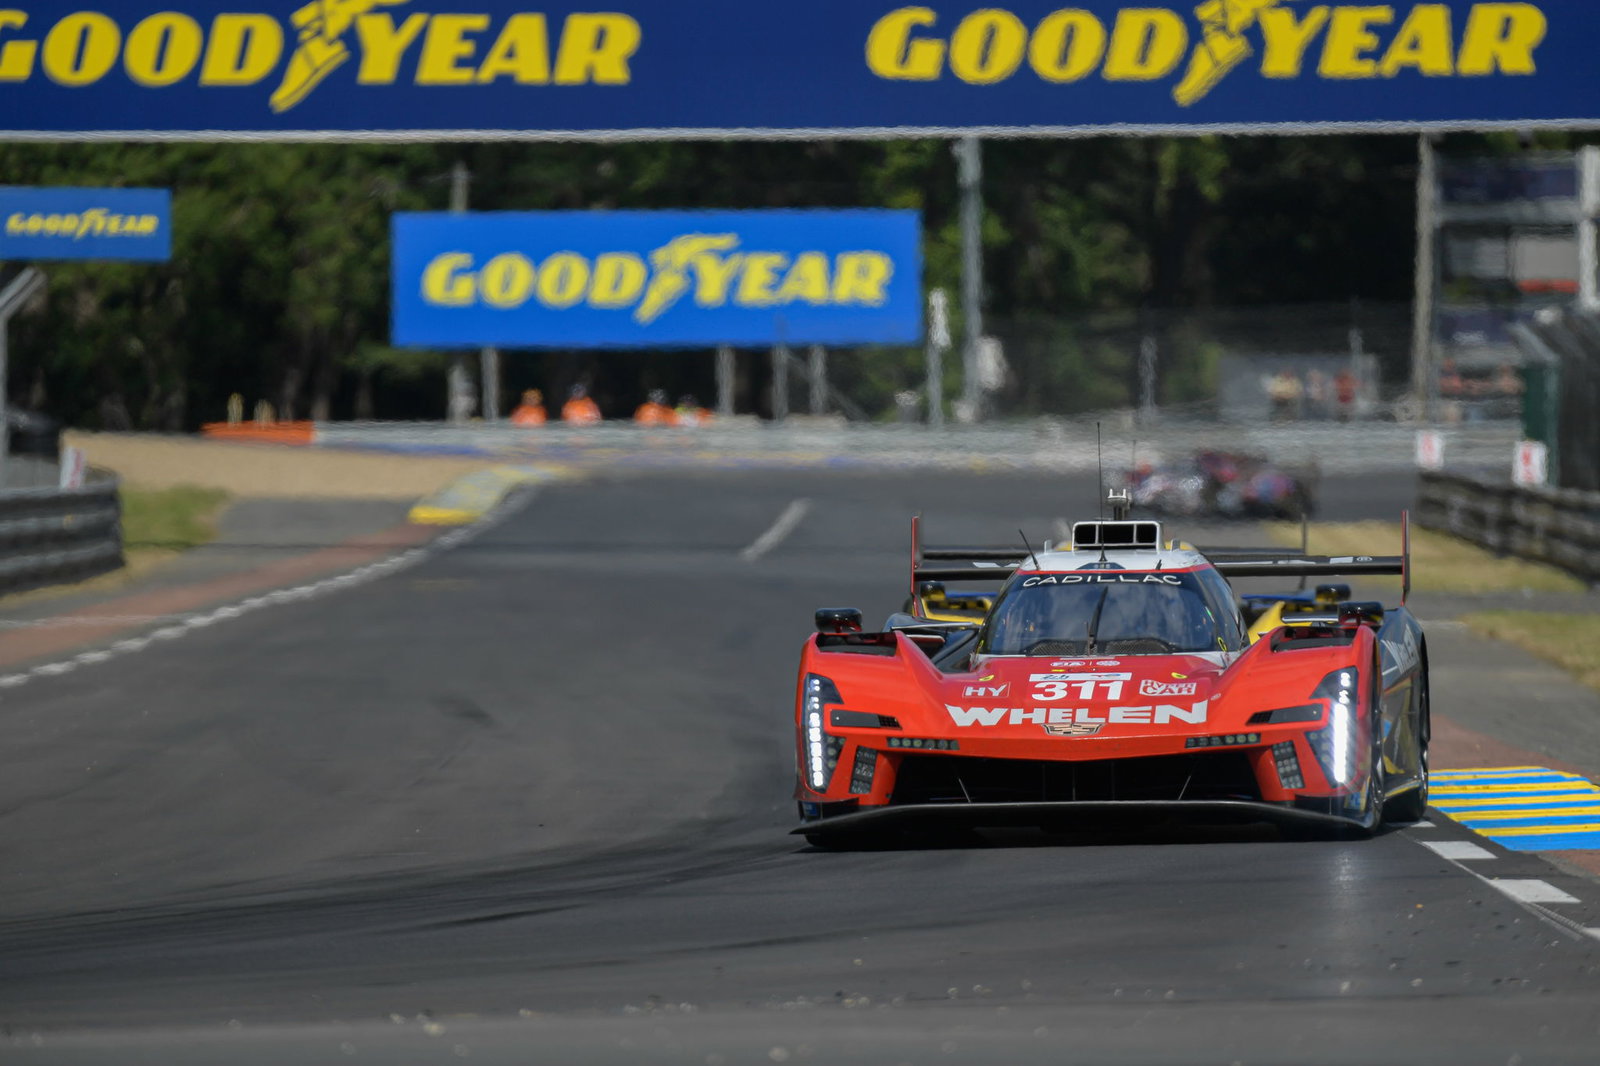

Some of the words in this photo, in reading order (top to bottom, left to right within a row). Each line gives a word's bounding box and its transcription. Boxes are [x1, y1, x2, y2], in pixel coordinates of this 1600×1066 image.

[866, 3, 1547, 84] GOODYEAR
[5, 210, 159, 237] GOODYEAR
[421, 251, 893, 308] GOODYEAR
[1022, 574, 1182, 587] CADILLAC
[964, 685, 1007, 696] HY
[1031, 681, 1125, 701] 311
[945, 702, 1208, 727] WHELEN
